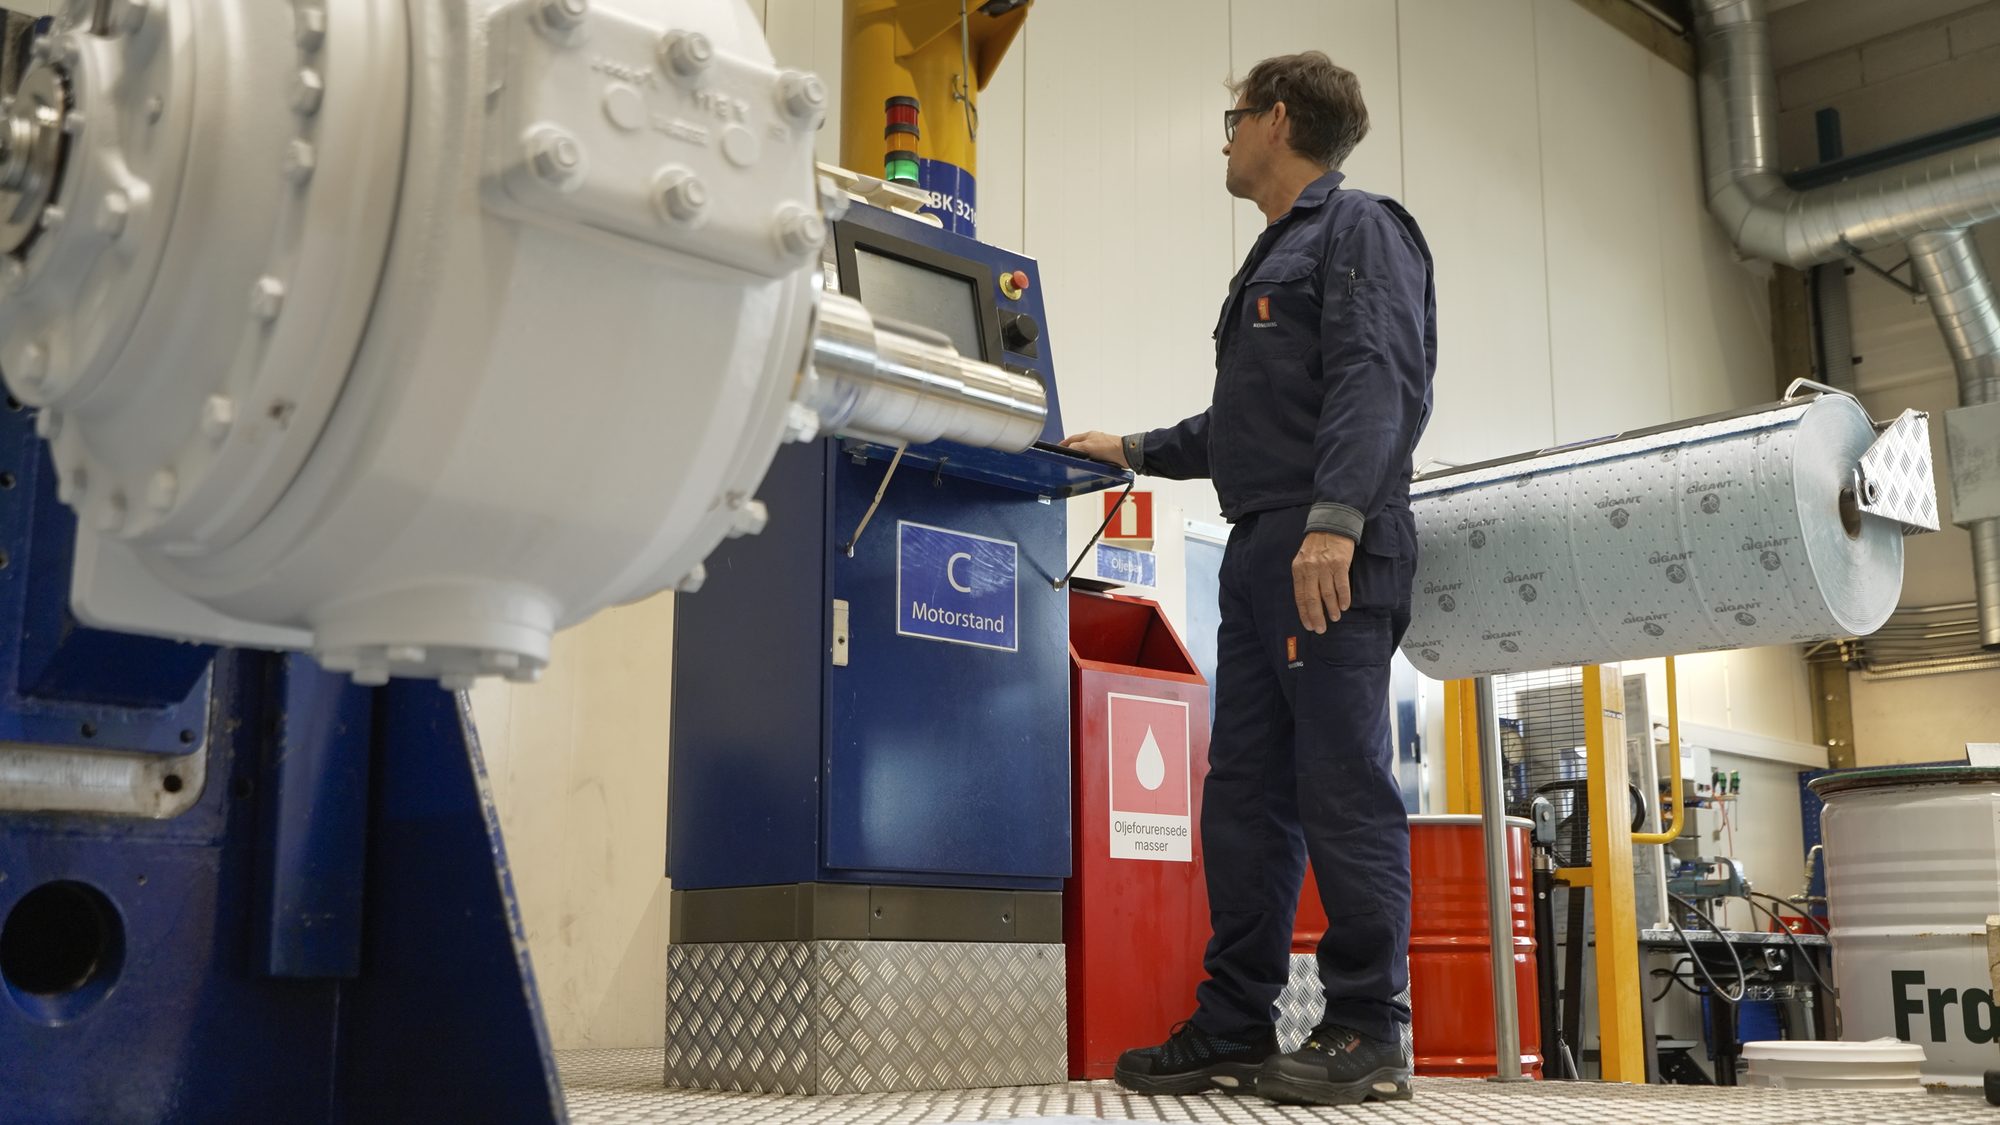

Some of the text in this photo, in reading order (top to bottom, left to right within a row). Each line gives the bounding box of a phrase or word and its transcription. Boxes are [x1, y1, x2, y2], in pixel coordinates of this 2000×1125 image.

[926, 191, 977, 228] BK 321
[1686, 481, 1736, 495] GIGANT
[1596, 495, 1642, 510] GIGANT
[1457, 517, 1499, 531] GIGANT
[1741, 536, 1792, 551] GIGANT
[1648, 551, 1694, 565] GIGANT
[947, 552, 972, 593] C
[1503, 570, 1547, 584] GIGANT
[1714, 602, 1763, 614] GIGANT
[912, 601, 1005, 634] Motorstand
[1622, 612, 1671, 625] GIGANT
[1114, 820, 1188, 837] Oljeforurensede
[1134, 840, 1169, 852] masser
